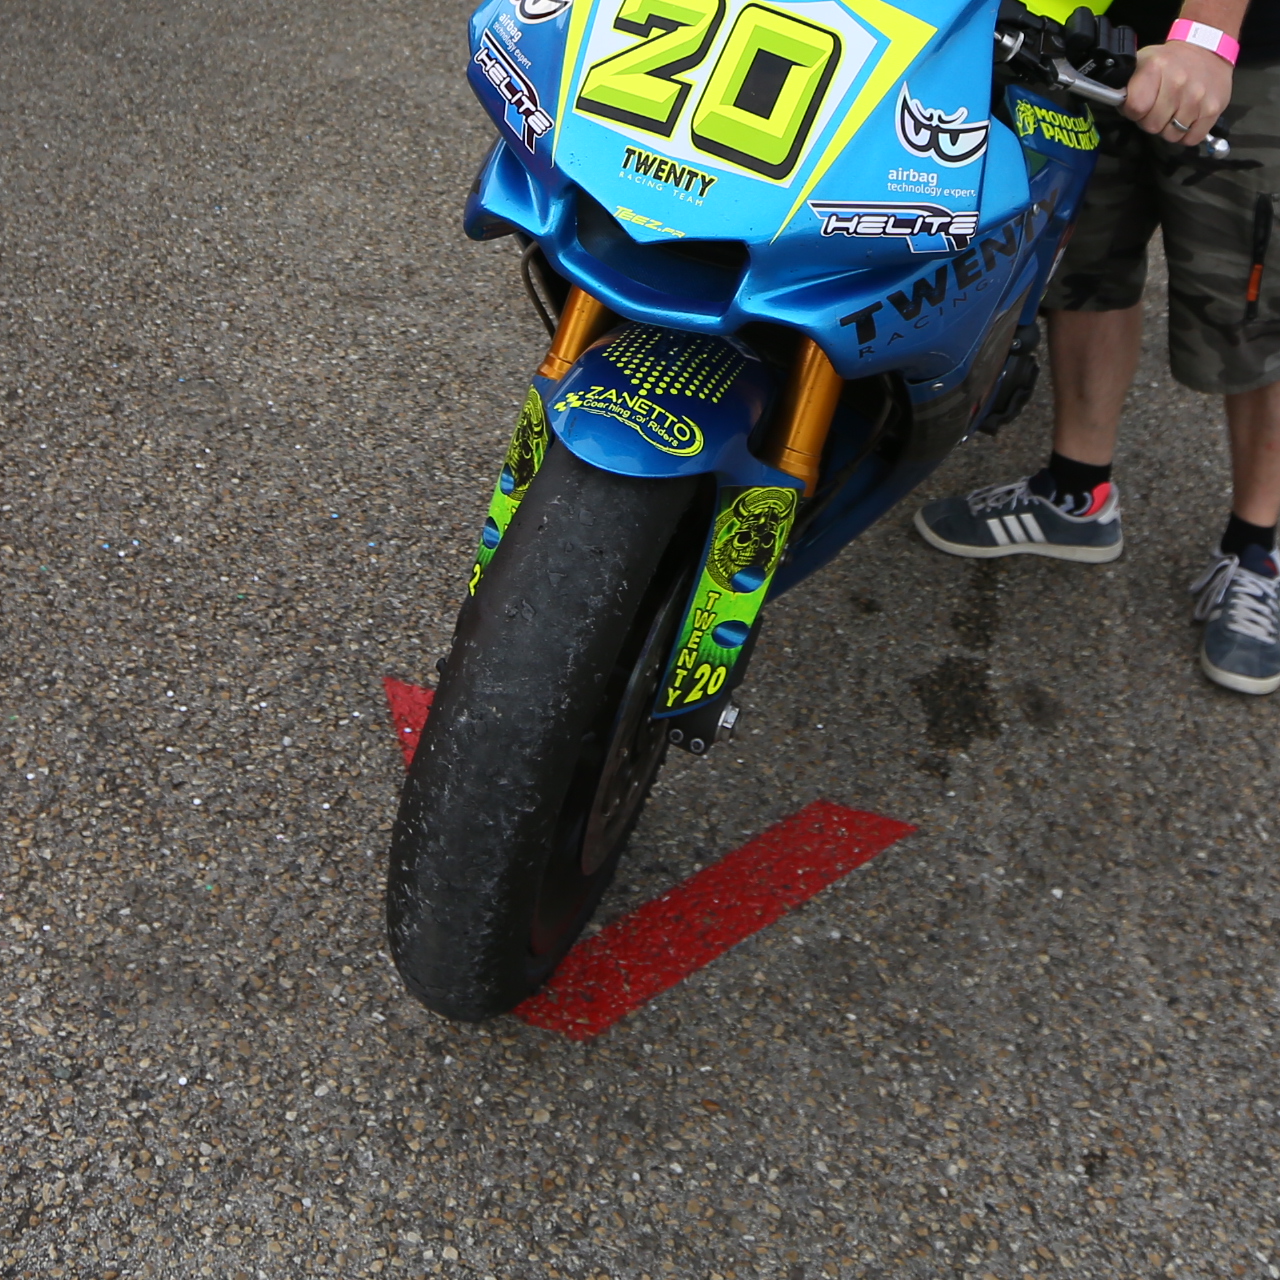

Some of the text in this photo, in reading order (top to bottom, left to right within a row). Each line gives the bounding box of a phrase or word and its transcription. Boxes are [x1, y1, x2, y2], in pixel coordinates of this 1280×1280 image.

[493, 24, 532, 70] technology expert
[499, 12, 523, 42] airbag
[475, 47, 554, 137] HELITE
[619, 171, 705, 207] RACING TEAM
[622, 147, 717, 198] TWENTY
[887, 167, 938, 186] airbag
[887, 182, 976, 199] technology expert
[822, 212, 979, 237] HELITE
[840, 188, 1058, 346] TWENTY
[585, 385, 691, 442] ZANETTO
[647, 420, 680, 448] Riders
[666, 591, 721, 708] TWENTY
[683, 663, 727, 705] 20
